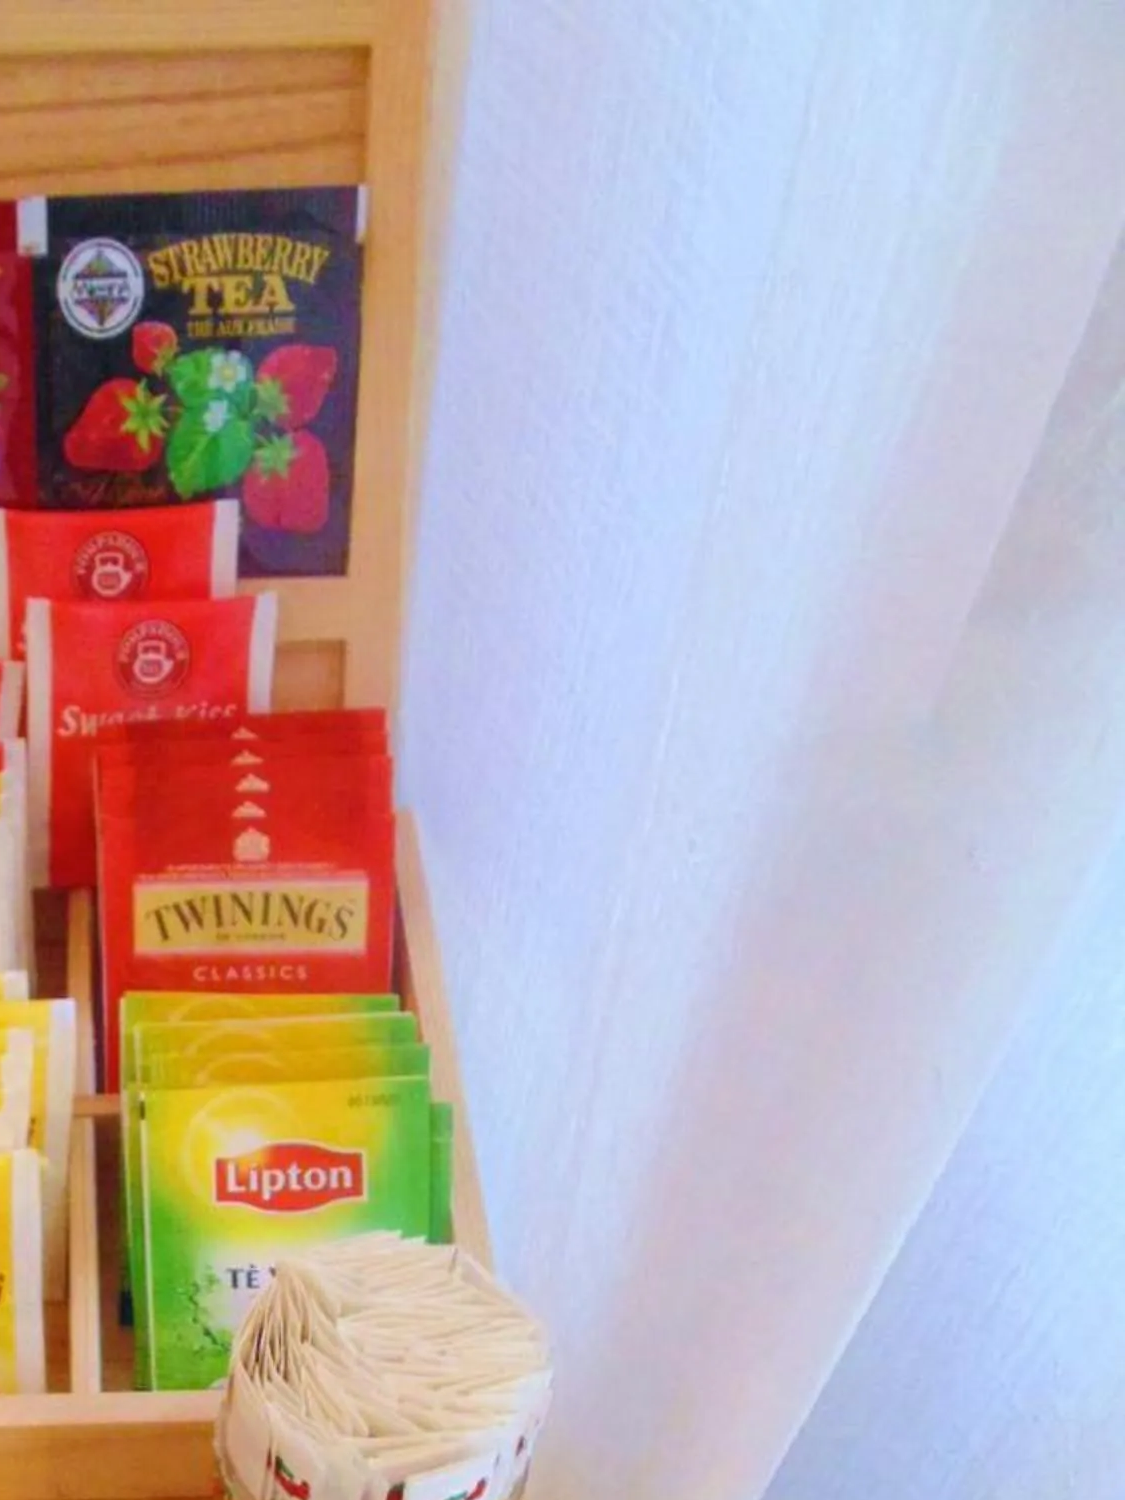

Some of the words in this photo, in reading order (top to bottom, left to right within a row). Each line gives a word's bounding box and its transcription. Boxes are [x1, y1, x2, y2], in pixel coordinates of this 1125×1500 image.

[147, 233, 330, 288] STRAWBERRY
[181, 273, 296, 316] TEA
[144, 889, 356, 942] TWININGS
[192, 964, 309, 982] CLASSICS
[226, 1160, 354, 1200] Lipton
